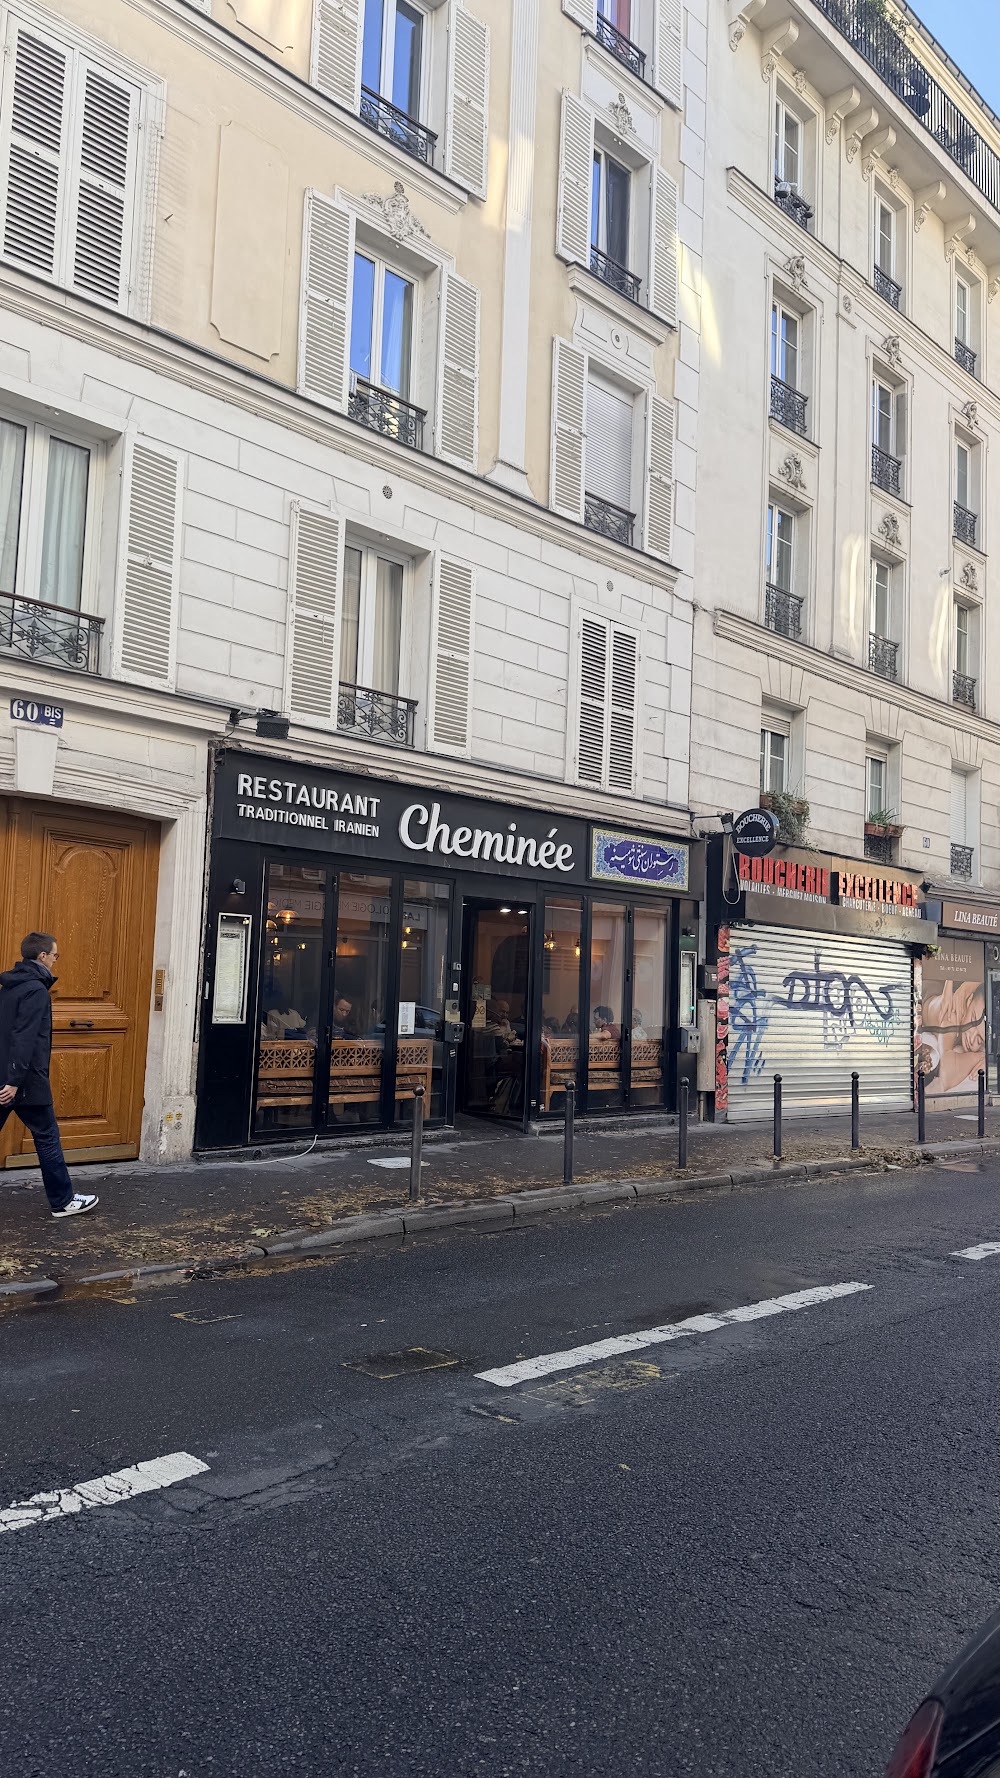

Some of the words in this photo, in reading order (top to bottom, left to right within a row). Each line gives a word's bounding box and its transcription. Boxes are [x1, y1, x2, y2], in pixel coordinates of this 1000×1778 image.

[12, 700, 39, 721] 60
[44, 705, 62, 720] BIS
[237, 773, 381, 818] RESTAURANT
[236, 803, 329, 830] TRADITIONNEL
[333, 819, 380, 838] IRANIEN
[735, 813, 772, 835] BOUCHERIE
[400, 802, 576, 873] Cheminée
[736, 835, 770, 844] EXCELLENCE
[609, 844, 636, 869] شومینه
[640, 853, 674, 876] رستوران
[738, 853, 830, 897] BOUCHERIE
[838, 871, 919, 908] EXCELLENCE
[740, 879, 771, 895] VOLAILLES
[954, 910, 971, 924] LINA
[971, 913, 998, 927] BEAUTÉ
[950, 953, 972, 964] BEAUTÉ
